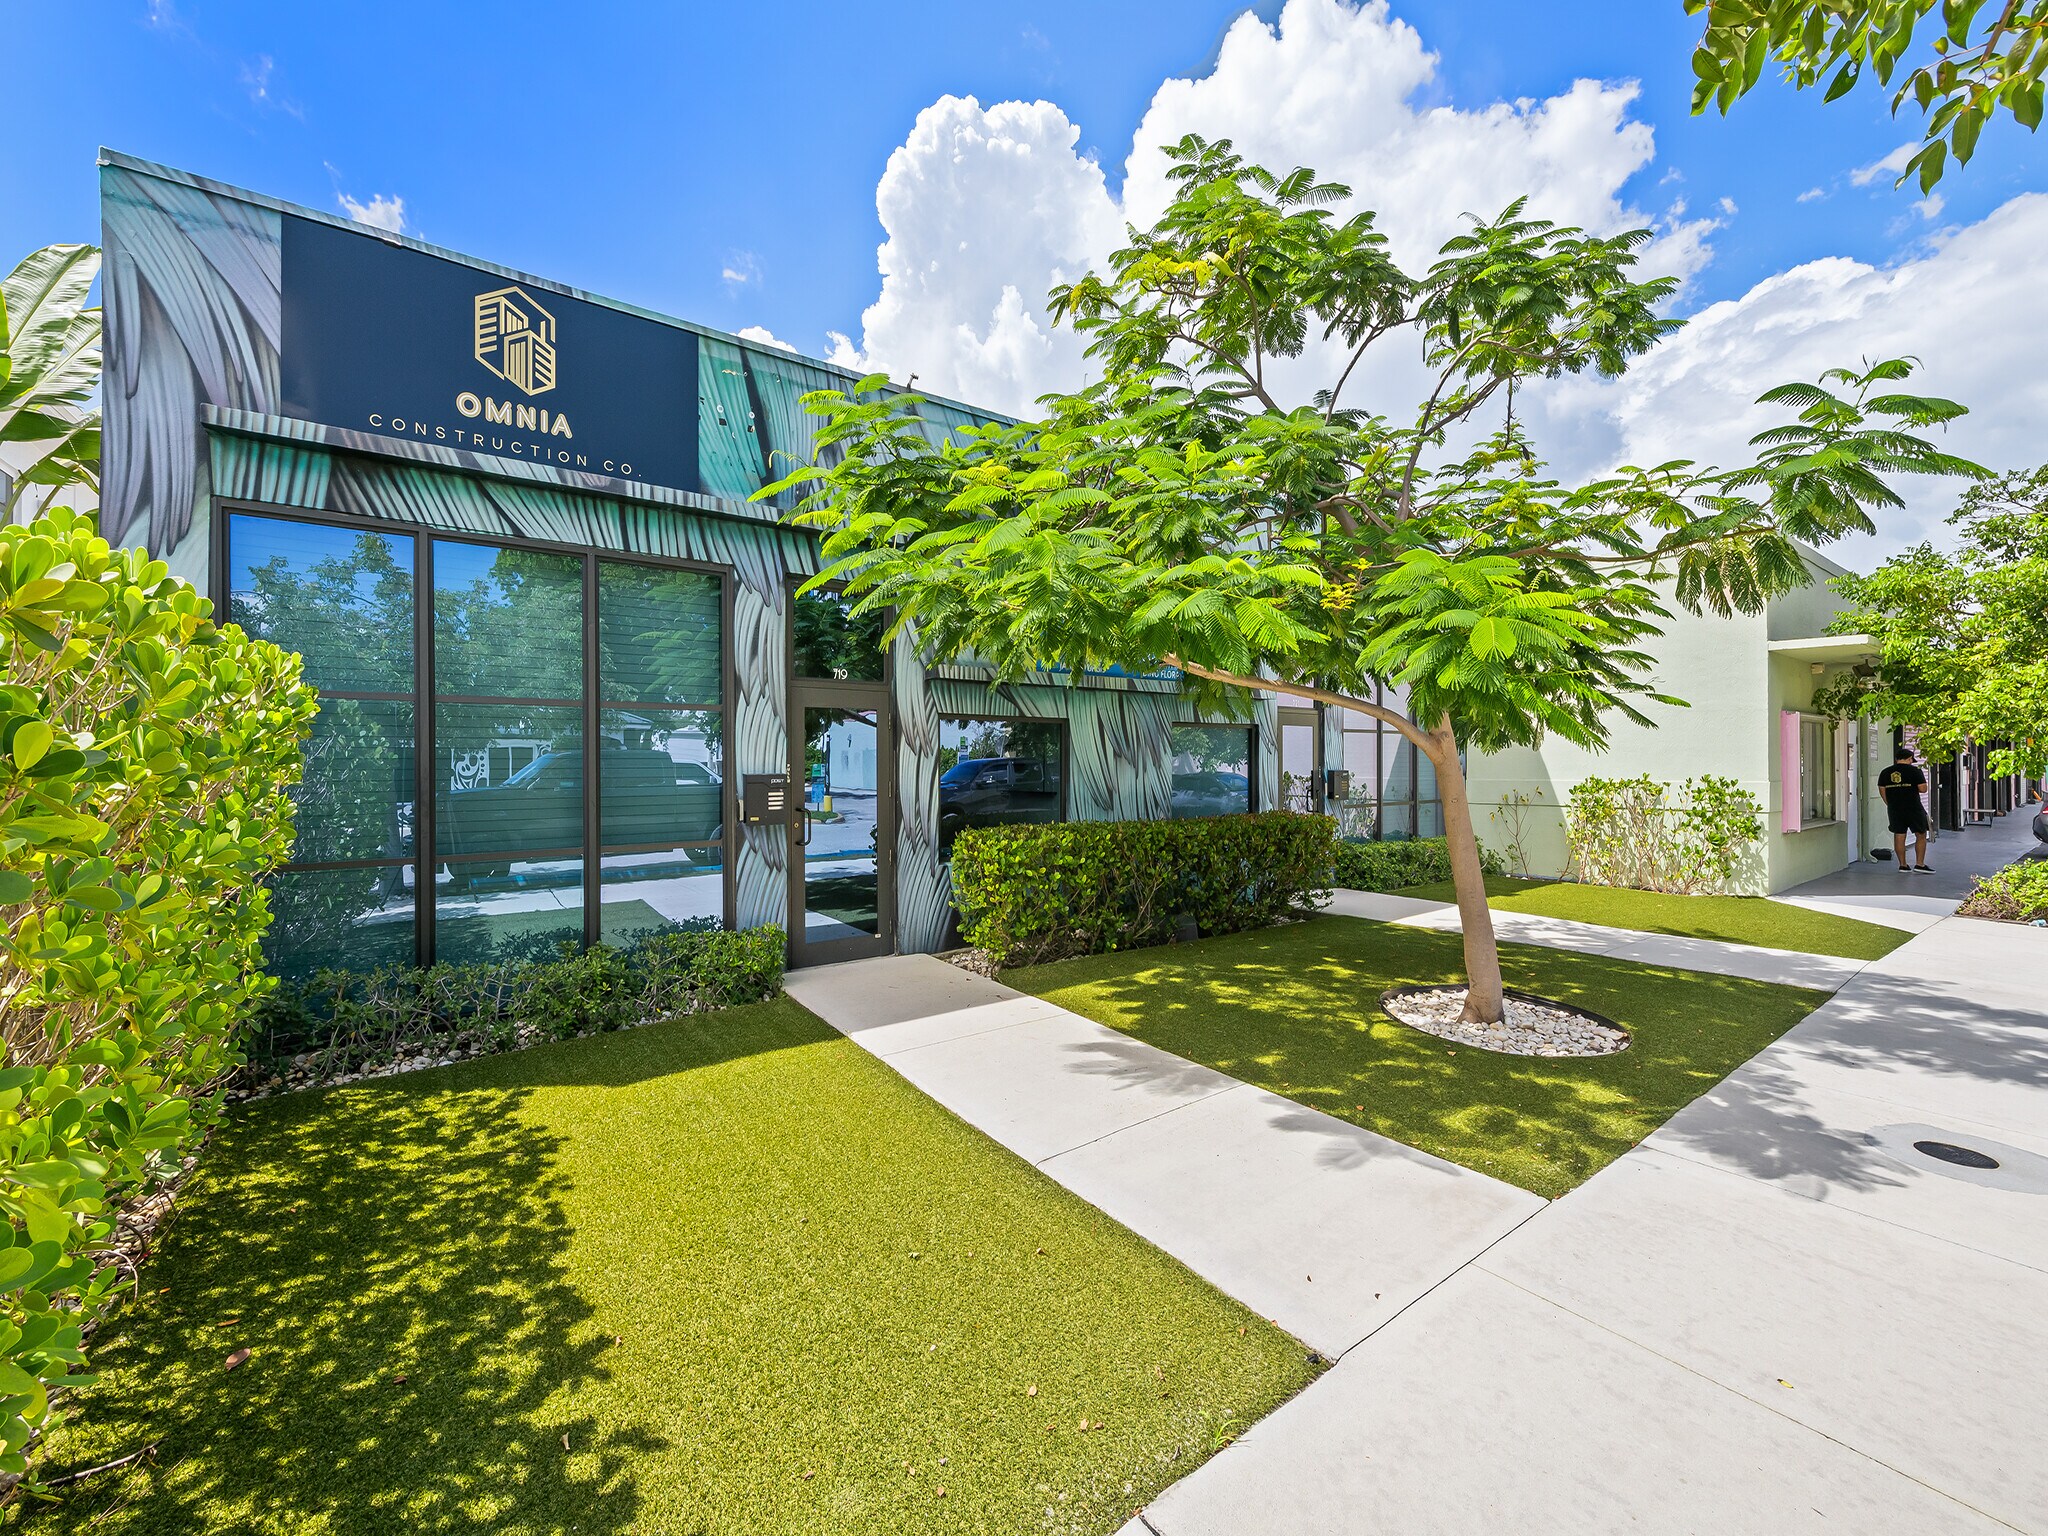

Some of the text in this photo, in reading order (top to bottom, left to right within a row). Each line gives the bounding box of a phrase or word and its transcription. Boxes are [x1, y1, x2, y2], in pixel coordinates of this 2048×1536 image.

[456, 391, 573, 439] OMNIA
[369, 413, 642, 477] CONSTRUCTION CO.
[832, 667, 848, 680] 719
